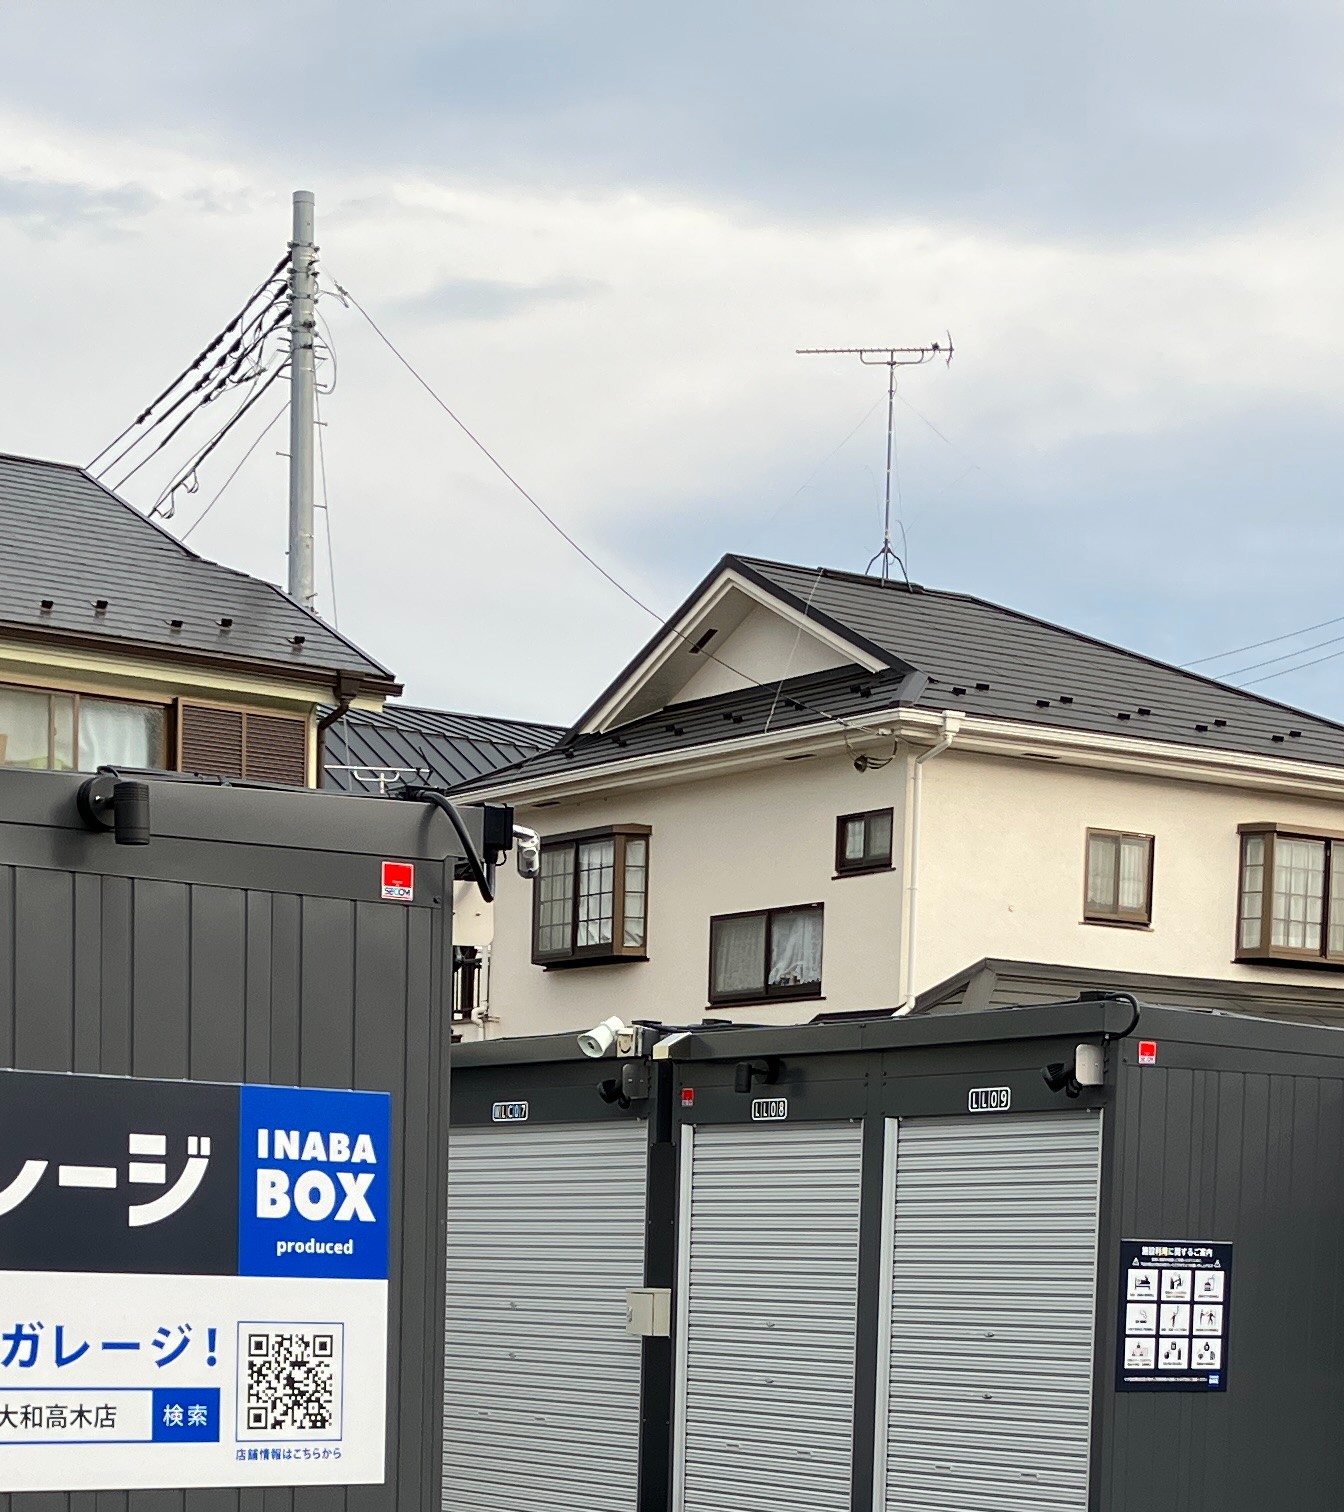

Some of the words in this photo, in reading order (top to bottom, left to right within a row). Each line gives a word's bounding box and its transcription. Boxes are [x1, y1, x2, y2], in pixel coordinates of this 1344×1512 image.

[971, 1089, 1008, 1109] LL09
[256, 1127, 377, 1165] INABA
[255, 1167, 377, 1223] BOX
[276, 1237, 354, 1256] produced
[162, 1403, 208, 1428] 検索
[235, 1447, 342, 1461] 店舗情報はこちらから
